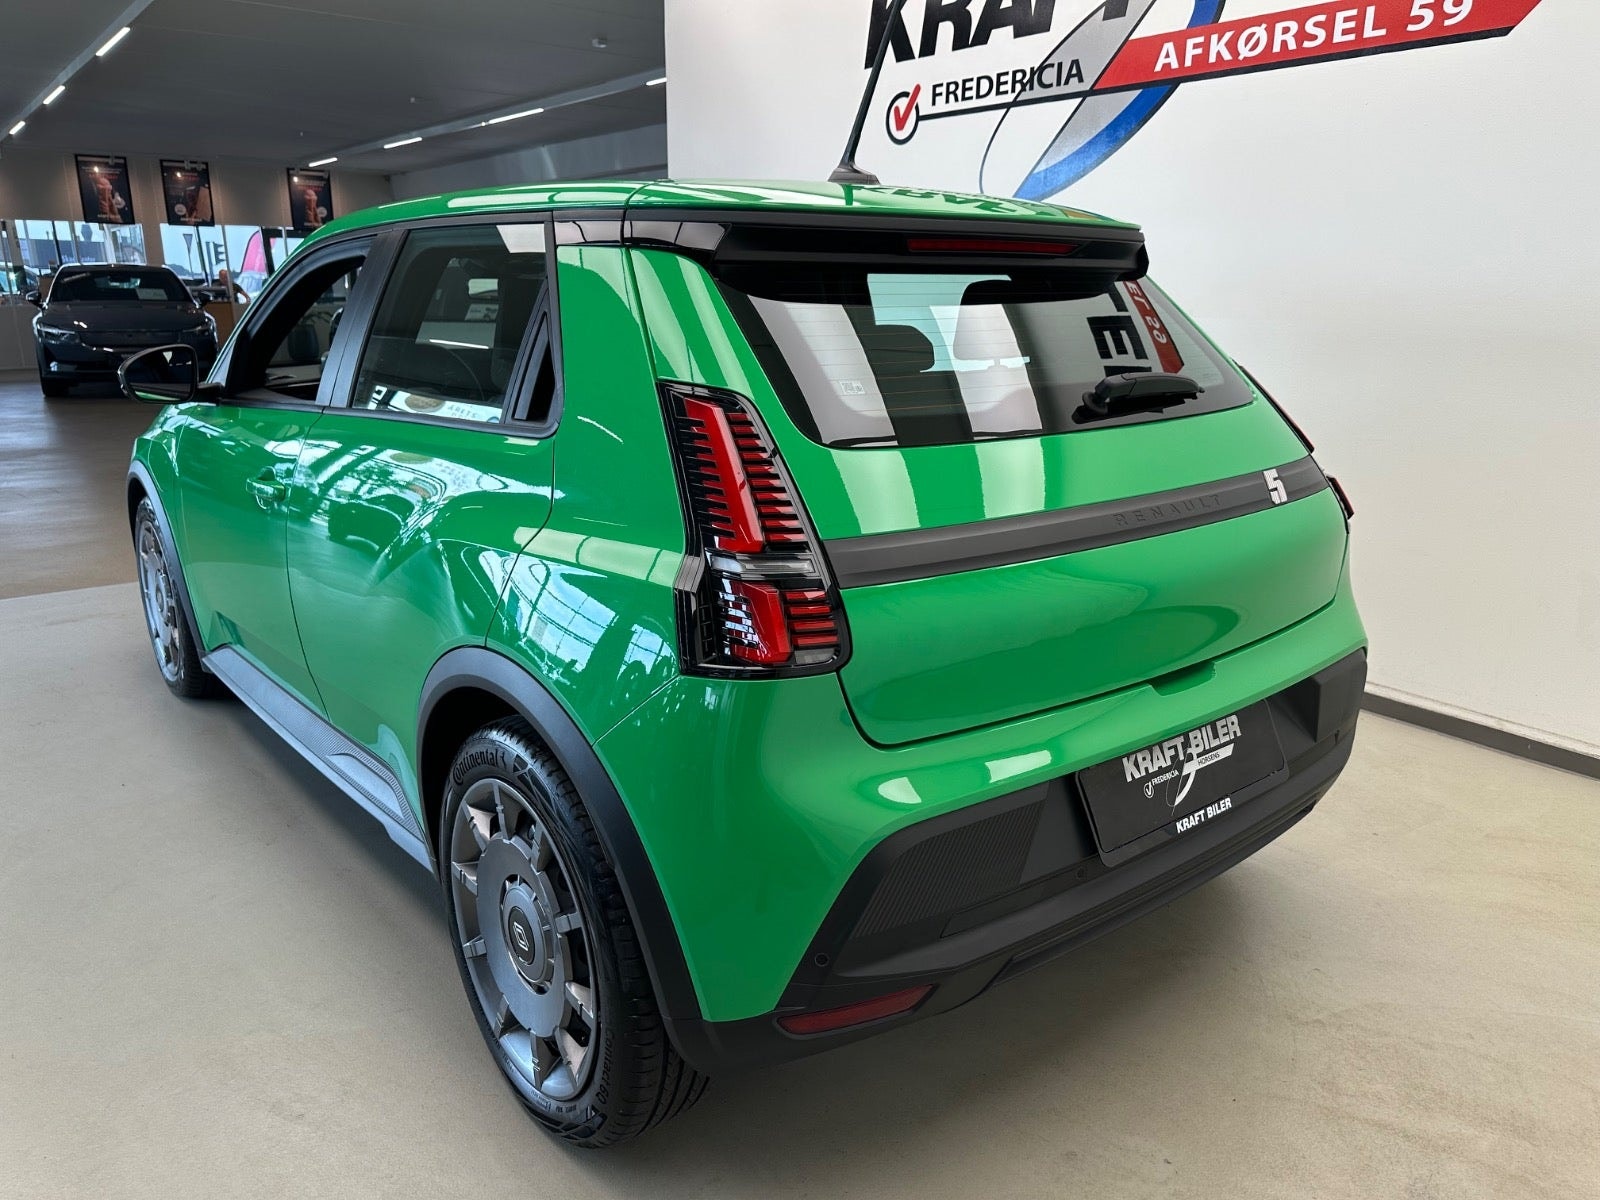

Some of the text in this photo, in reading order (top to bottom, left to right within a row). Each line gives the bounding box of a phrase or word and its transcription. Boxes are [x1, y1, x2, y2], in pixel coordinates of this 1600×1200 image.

[1153, 0, 1473, 72] AFKØRSEL 59
[931, 58, 1085, 106] FREDERICIA
[1262, 468, 1288, 504] 5
[1112, 494, 1222, 526] RENAULT
[453, 748, 498, 785] Continental
[1122, 714, 1242, 783] KRAFT BILER
[1197, 752, 1220, 766] HORSENS
[1152, 769, 1179, 786] FREDERICIA
[1176, 797, 1232, 834] KRAFT BILER
